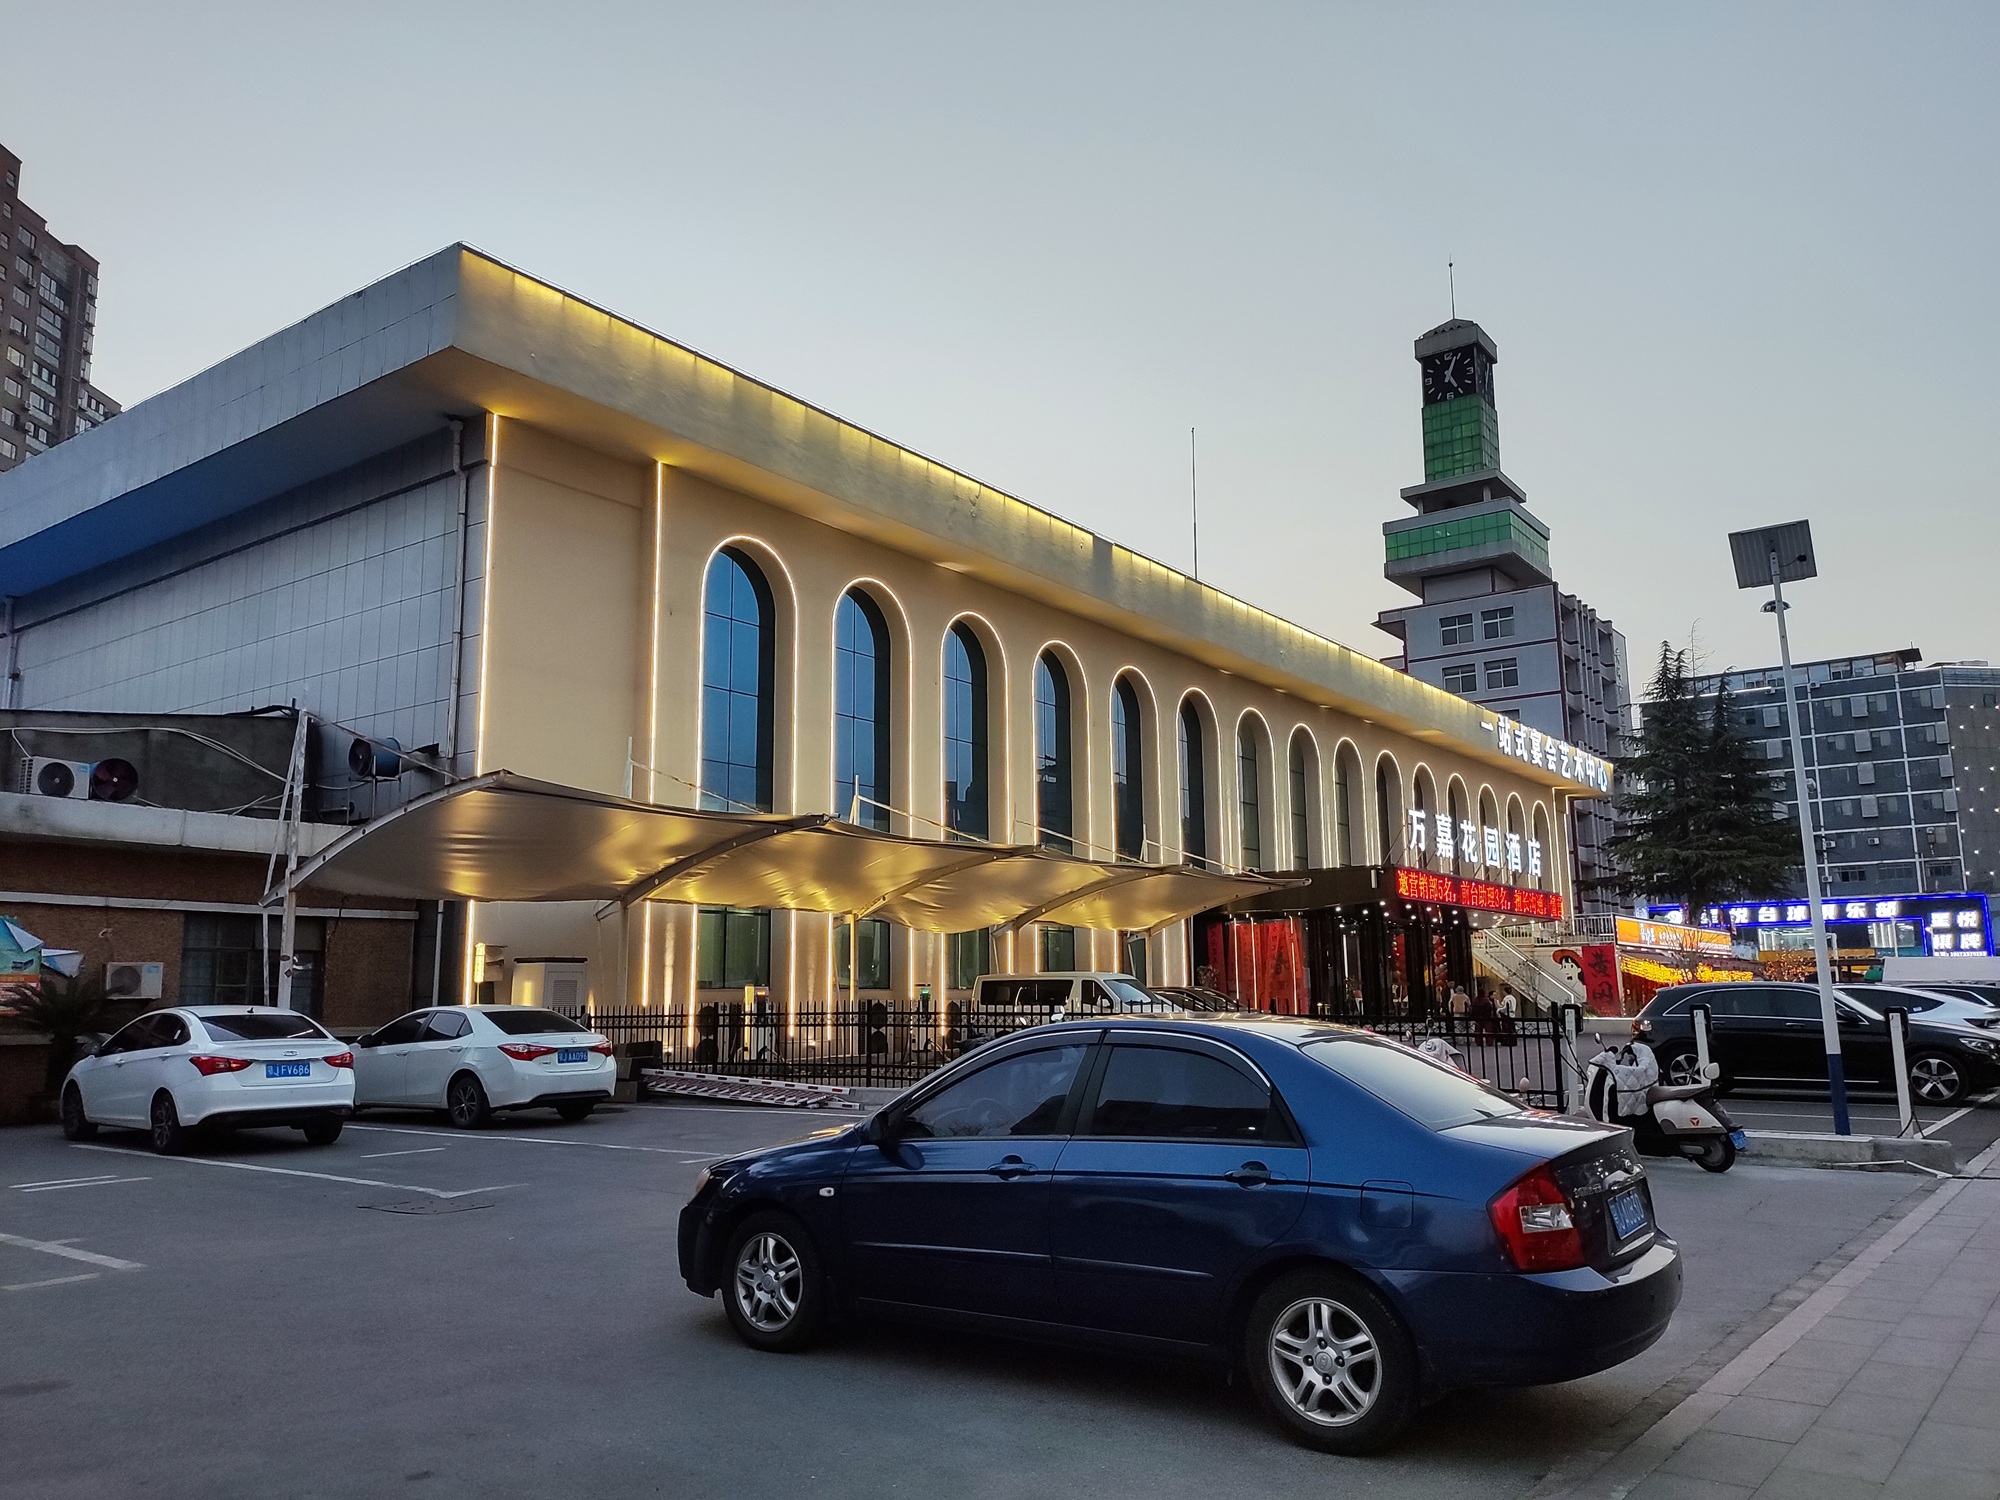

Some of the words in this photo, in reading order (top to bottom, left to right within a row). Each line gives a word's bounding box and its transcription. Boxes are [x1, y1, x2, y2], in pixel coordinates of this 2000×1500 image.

[1481, 714, 1608, 792] 一站式宴会艺术中心
[1408, 809, 1542, 877] 万嘉花园酒店
[1931, 910, 1978, 928] 星悦
[1932, 933, 1981, 949] 棋牌
